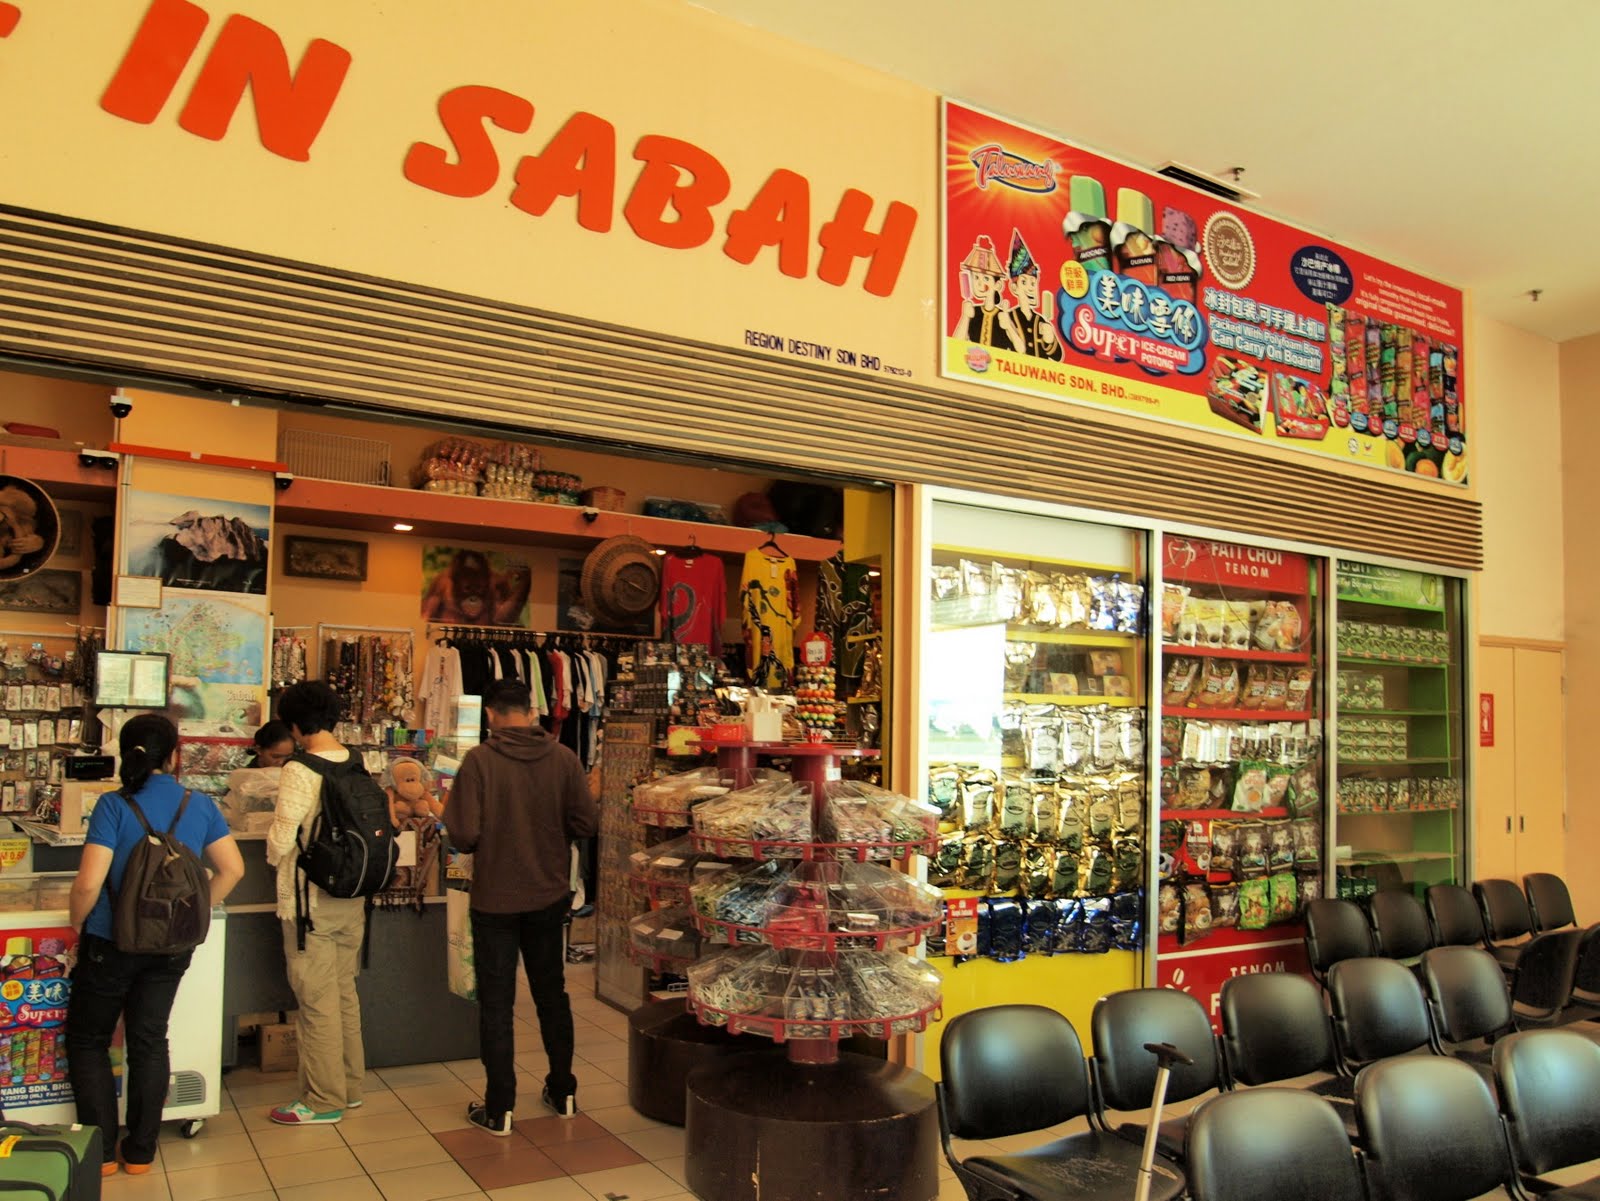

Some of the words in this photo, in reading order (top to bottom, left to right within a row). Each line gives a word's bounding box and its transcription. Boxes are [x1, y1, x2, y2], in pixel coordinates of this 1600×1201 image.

[99, 0, 351, 163] IN
[402, 84, 918, 299] SABAH
[1074, 307, 1140, 357] Super
[1209, 314, 1241, 335] Packed
[1241, 323, 1263, 340] With
[1263, 330, 1303, 352] Polyfoam
[1211, 329, 1234, 349] Can
[1235, 336, 1265, 359] Carry
[1266, 345, 1283, 362] On
[745, 329, 784, 352] REGION
[788, 338, 832, 361] DESTINY
[836, 348, 857, 367] SDN
[860, 353, 881, 371] BHD
[1141, 341, 1187, 362] ICE-CREAM
[1141, 352, 1174, 370] POTONG
[996, 358, 1066, 385] TALUWANG
[1070, 375, 1097, 392] SDN.
[1100, 382, 1128, 399] BHD.
[1225, 561, 1270, 578] TENOM
[27, 983, 65, 1002] 美味
[18, 1004, 62, 1023] Super
[28, 1084, 50, 1093] SDN.
